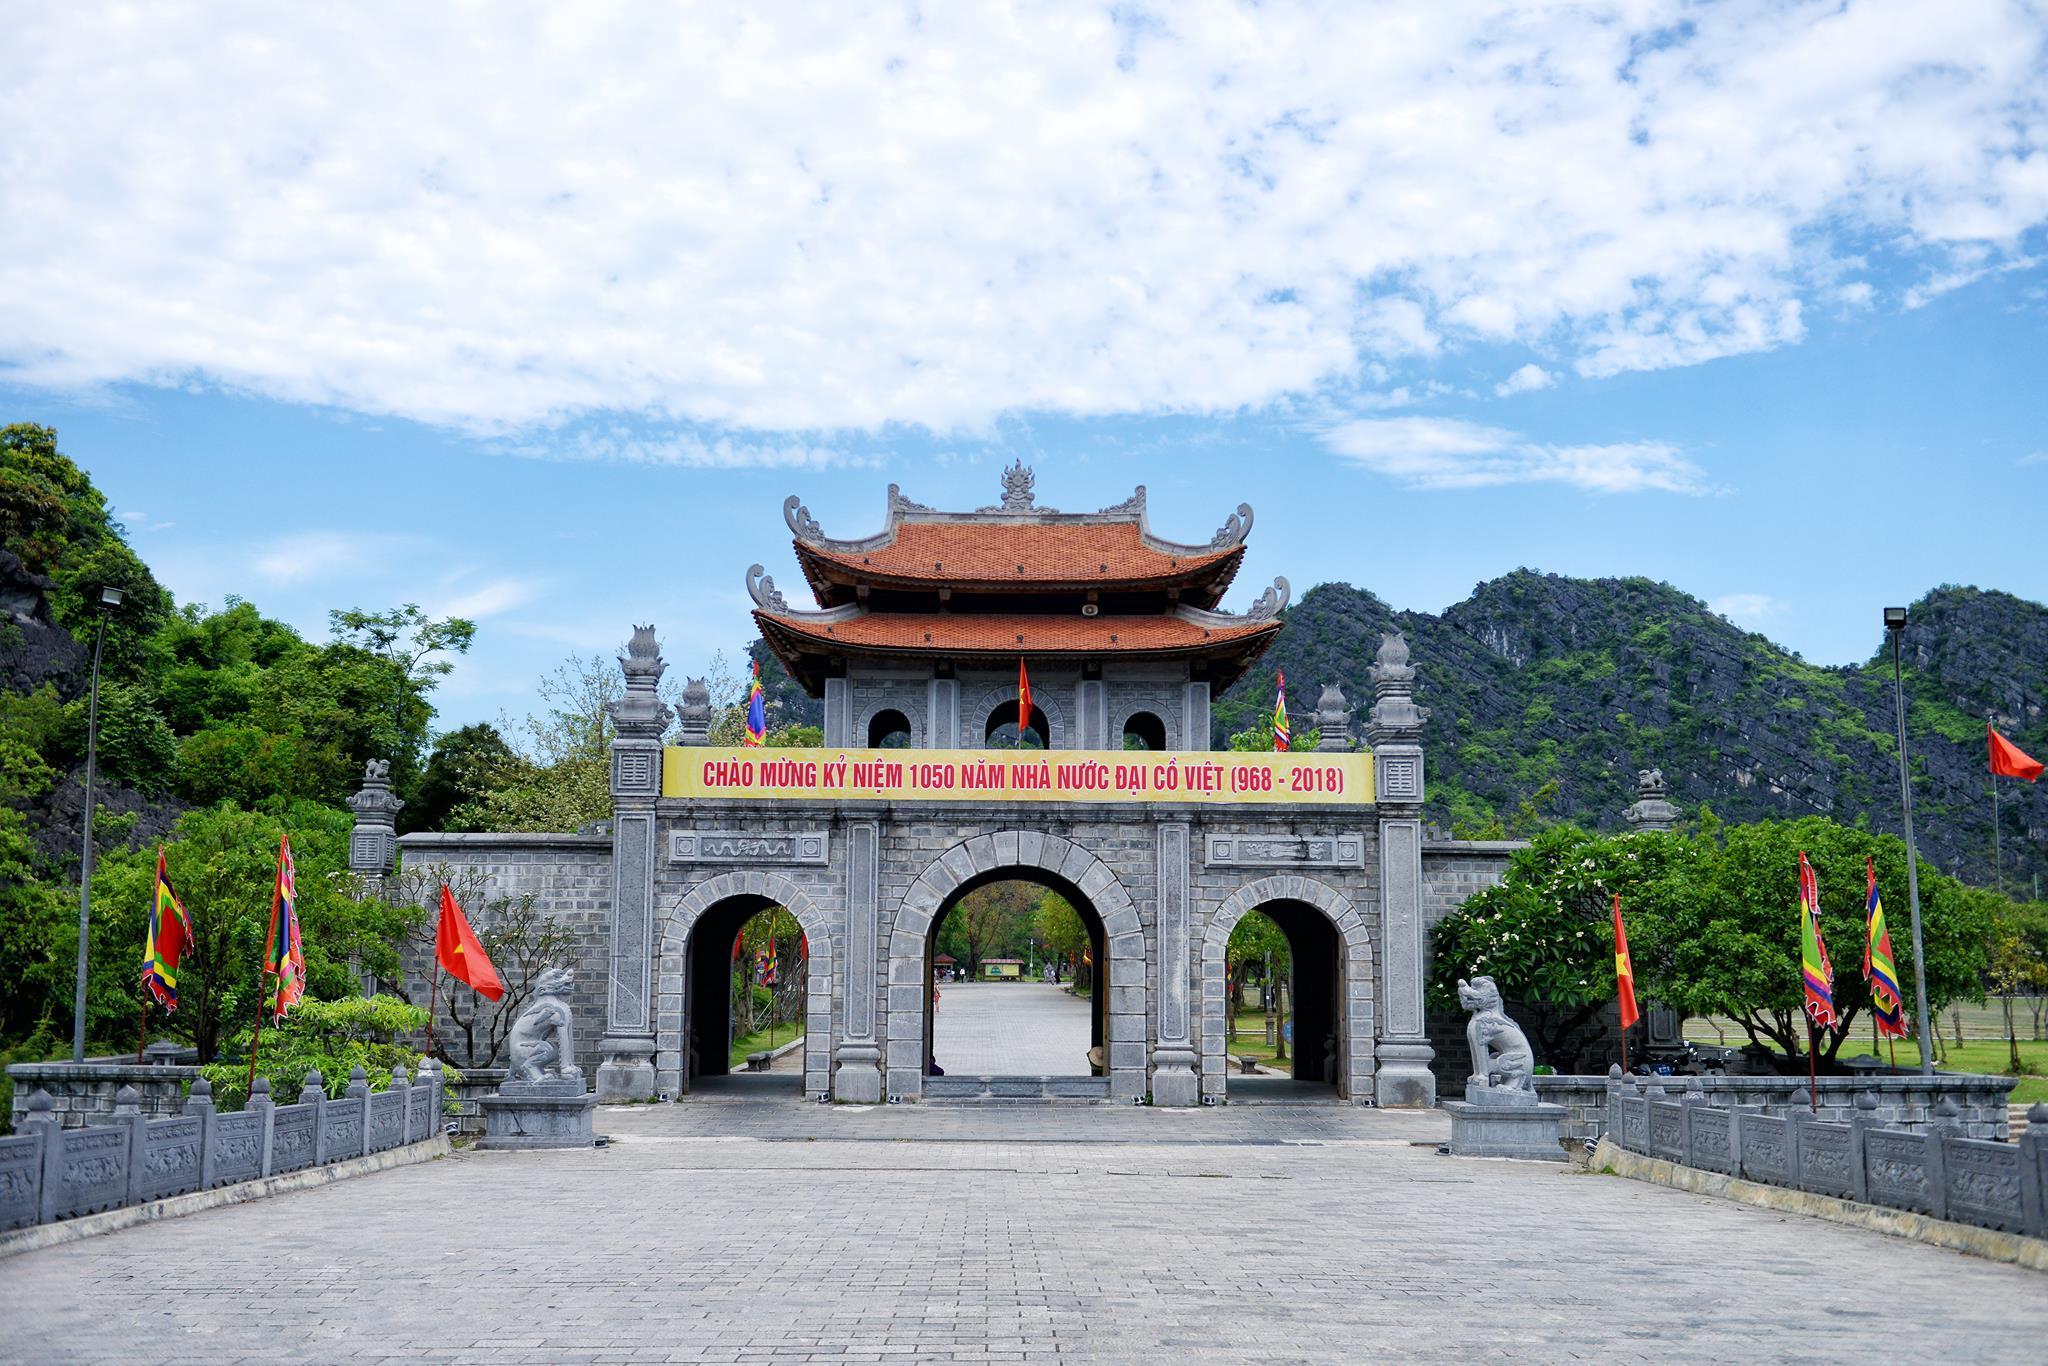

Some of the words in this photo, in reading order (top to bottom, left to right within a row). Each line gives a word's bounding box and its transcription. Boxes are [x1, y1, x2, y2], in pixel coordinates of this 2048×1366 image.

[703, 757, 754, 787] CHÀO
[760, 757, 817, 788] MỪNG
[823, 754, 847, 788] KỶ
[853, 758, 903, 794] NIỆM
[909, 764, 955, 789] 1050
[961, 759, 1006, 789] NĂM
[1011, 758, 1051, 790] NHÀ
[1057, 759, 1109, 790] NƯỚC
[1115, 765, 1147, 796] ĐẠI
[1184, 760, 1225, 796] VIỆT
[1231, 766, 1272, 793] (968
[1291, 767, 1344, 794] 2018)
